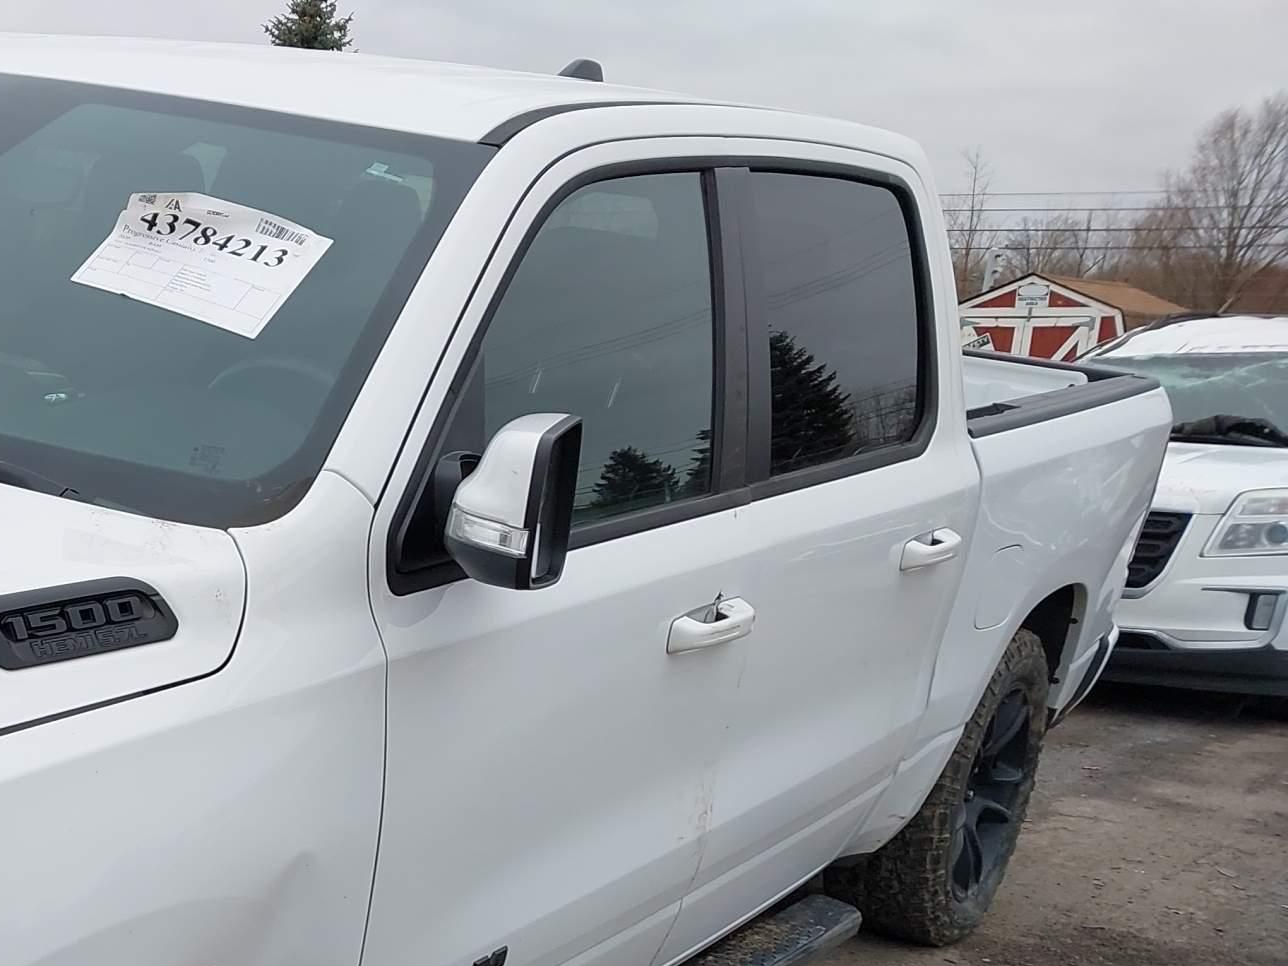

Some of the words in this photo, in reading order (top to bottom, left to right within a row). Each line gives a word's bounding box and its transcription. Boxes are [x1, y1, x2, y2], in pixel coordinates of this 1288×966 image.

[140, 212, 288, 267] 43784213
[1, 594, 146, 640] 1500
[31, 630, 96, 658] HEMI
